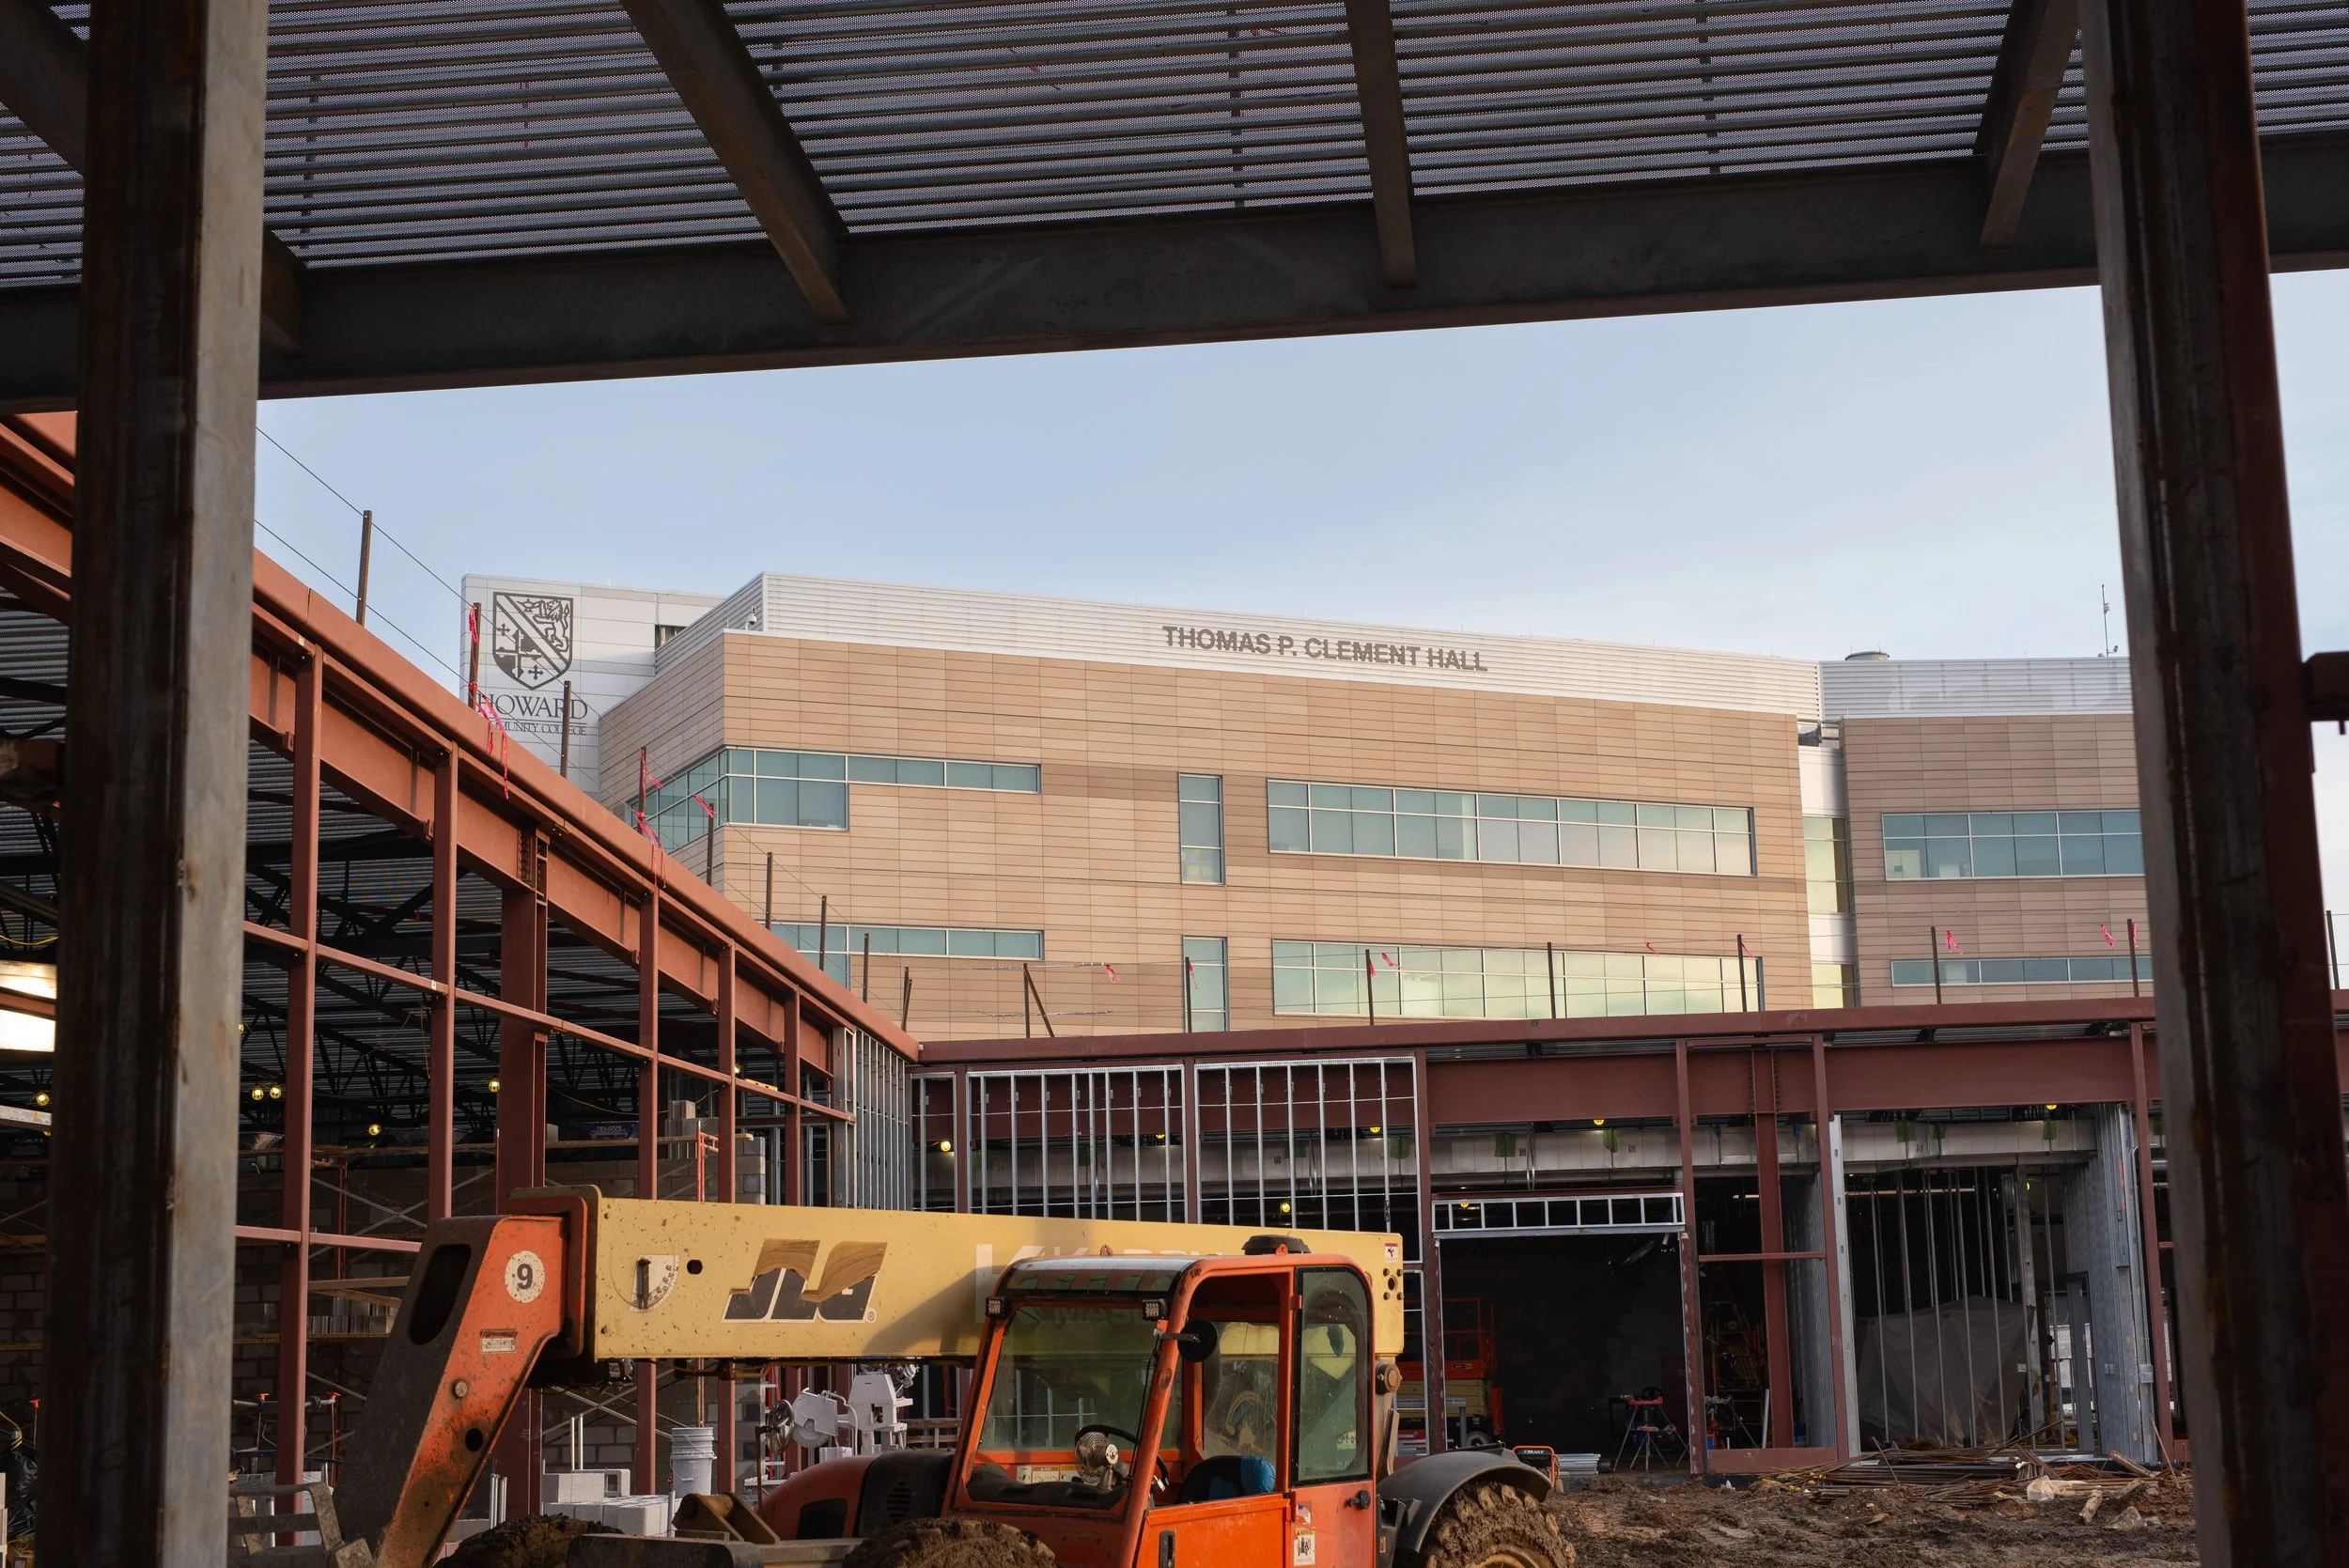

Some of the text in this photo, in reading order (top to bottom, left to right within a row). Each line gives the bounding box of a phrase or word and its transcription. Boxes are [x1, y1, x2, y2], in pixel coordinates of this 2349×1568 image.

[1162, 626, 1488, 672] THOMAS P. CLEMENT HALL
[541, 723, 586, 736] COLEGE
[517, 1263, 533, 1290] 9
